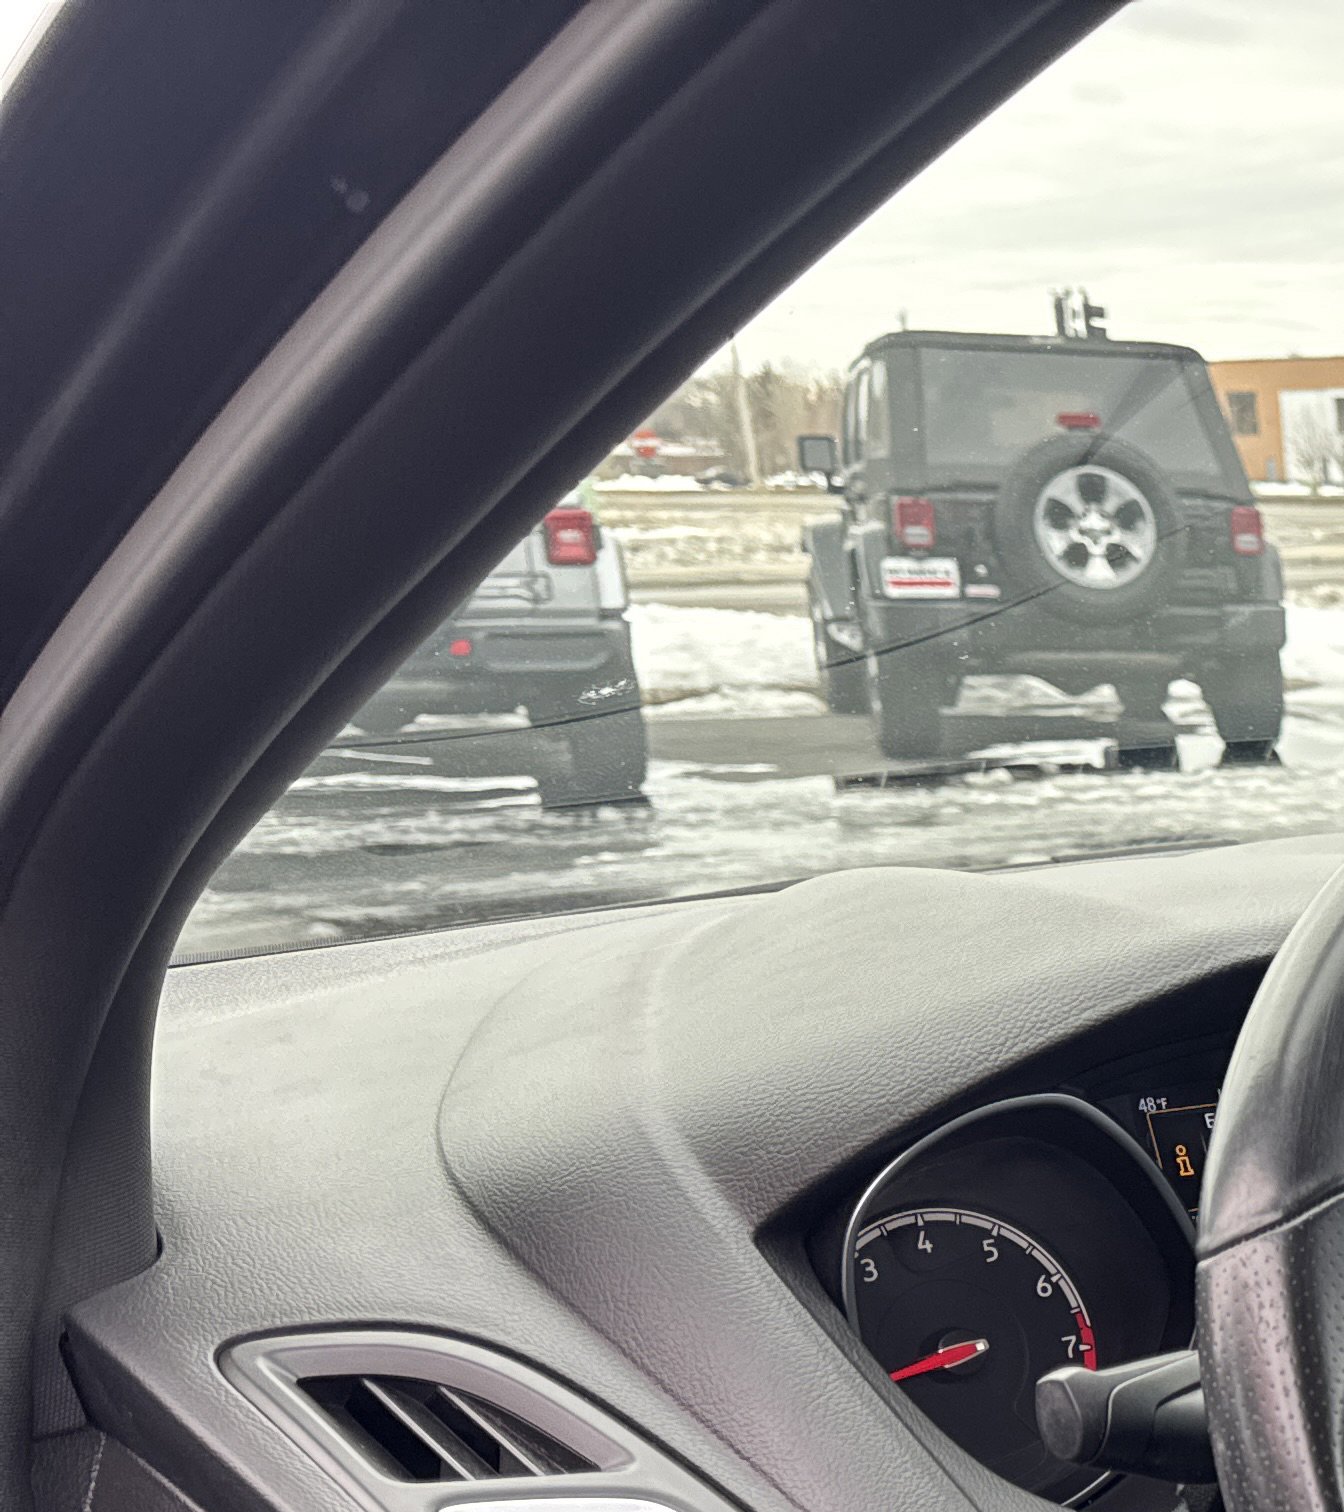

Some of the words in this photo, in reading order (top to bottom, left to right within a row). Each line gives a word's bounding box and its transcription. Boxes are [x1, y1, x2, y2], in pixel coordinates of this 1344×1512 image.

[1139, 1096, 1168, 1112] 48°F
[917, 1230, 934, 1253] 4
[982, 1239, 999, 1263] 5
[860, 1257, 879, 1283] 3
[1036, 1274, 1053, 1298] 6
[1061, 1335, 1077, 1358] 7
